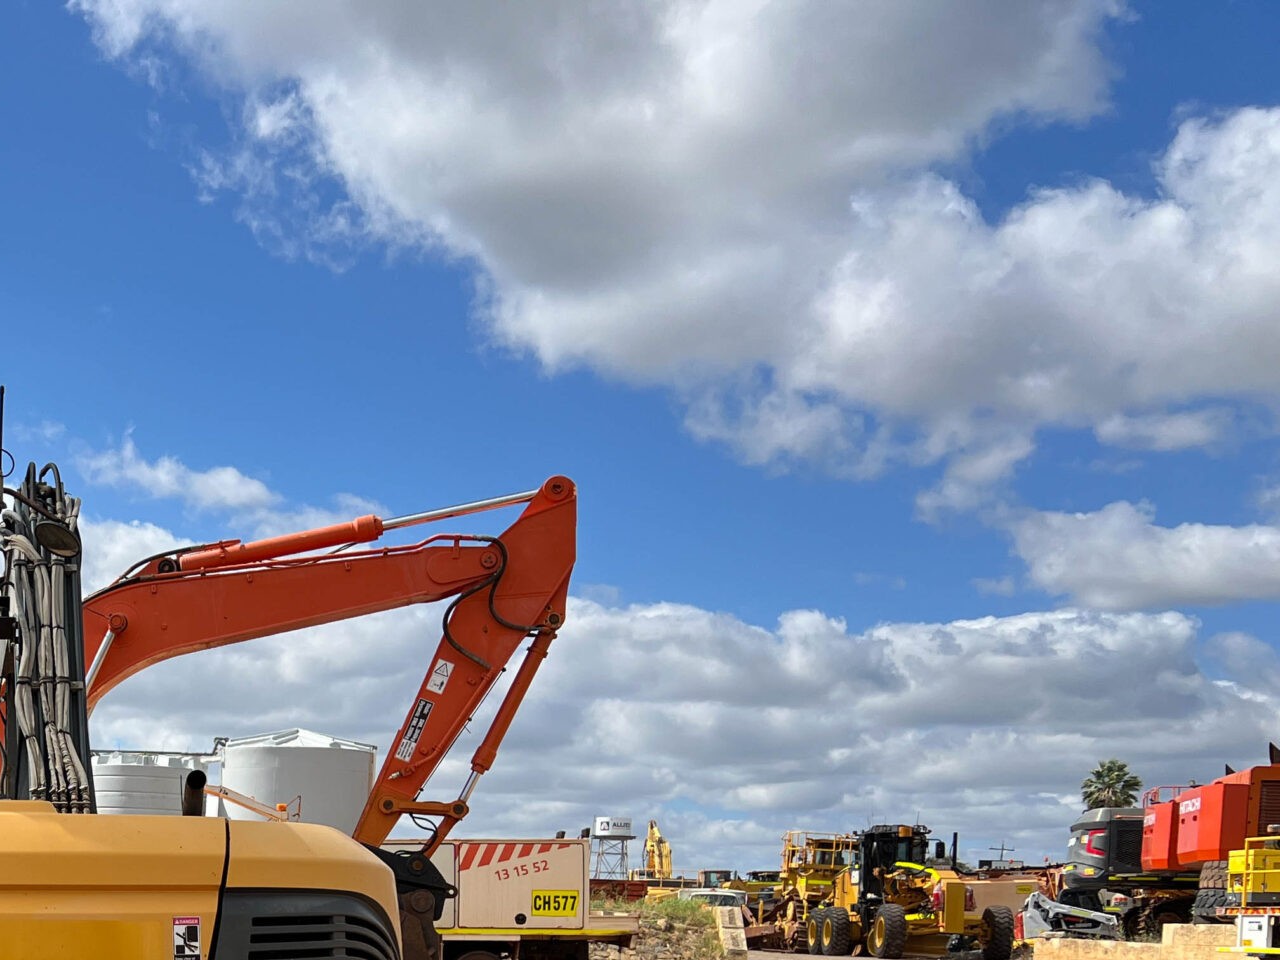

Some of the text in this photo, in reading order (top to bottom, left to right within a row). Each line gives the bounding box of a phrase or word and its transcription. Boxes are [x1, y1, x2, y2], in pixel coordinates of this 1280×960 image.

[495, 860, 550, 881] 13 15 52
